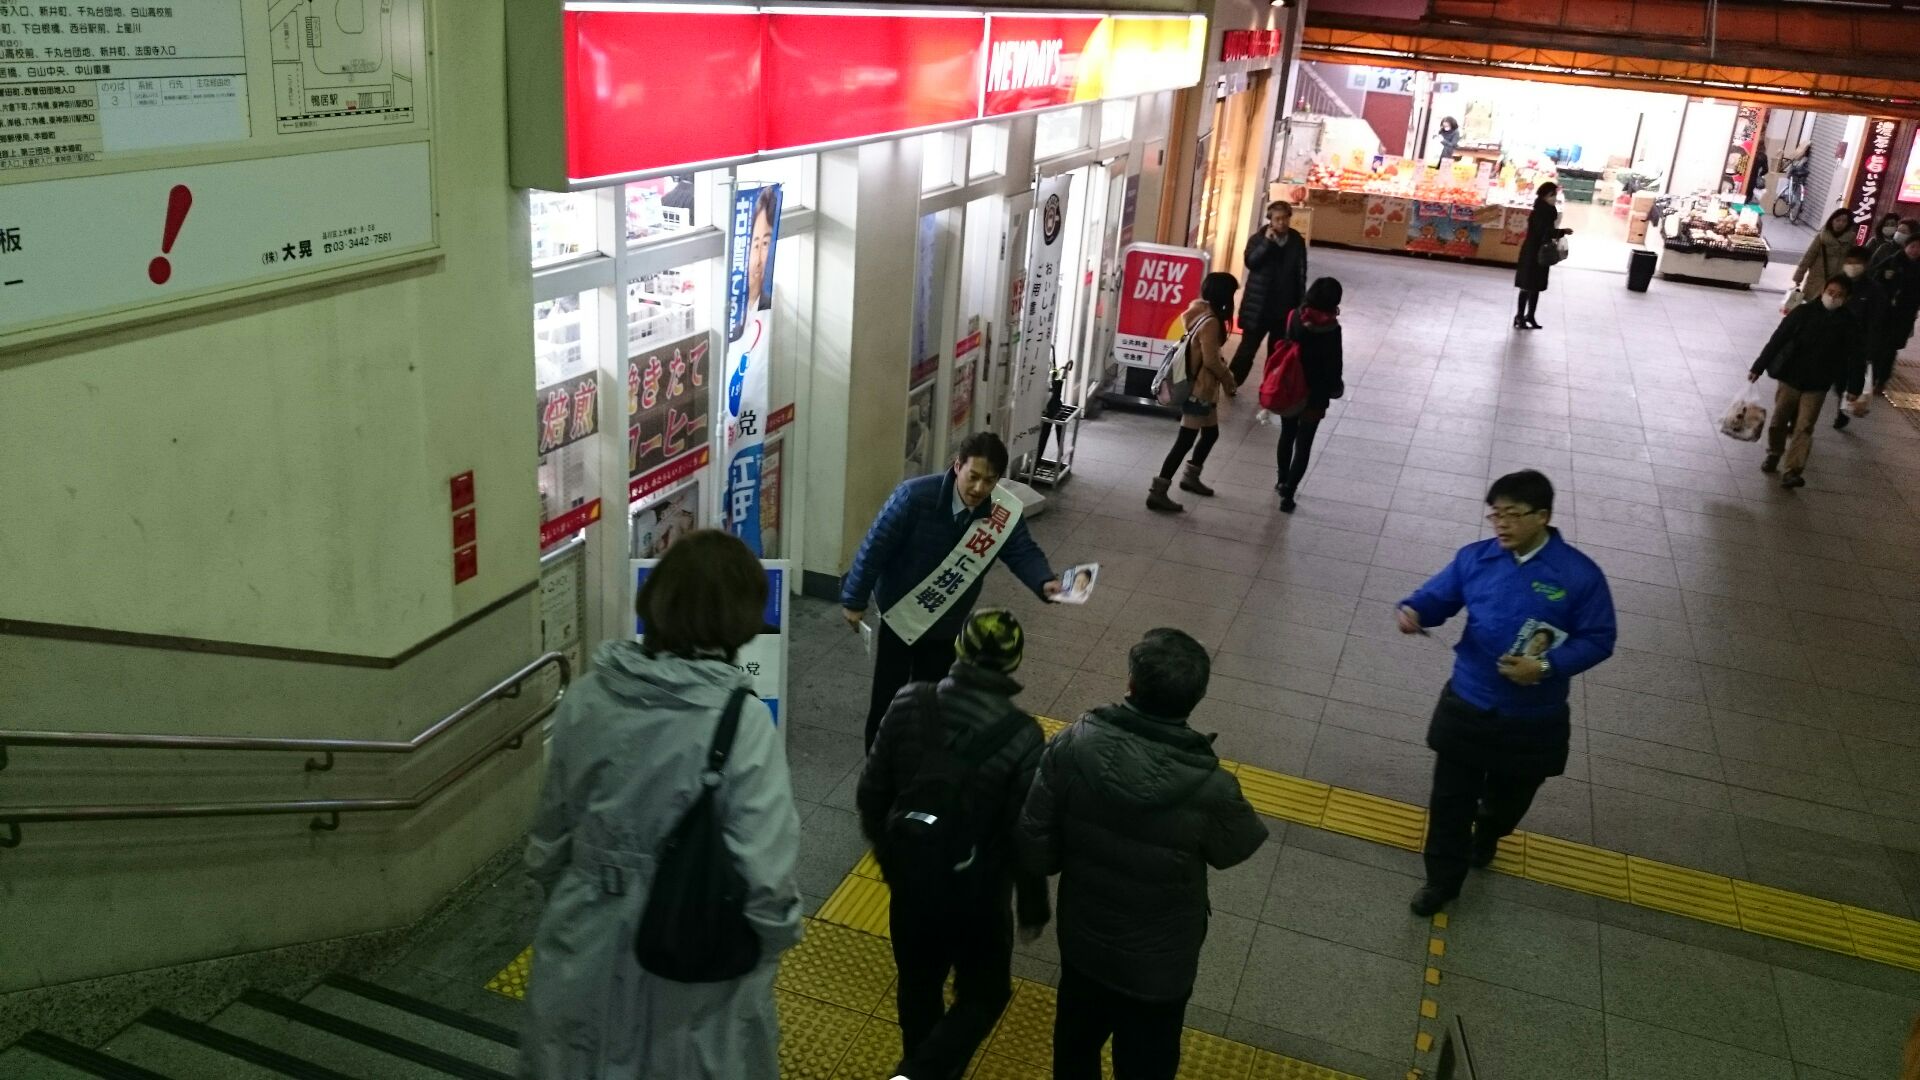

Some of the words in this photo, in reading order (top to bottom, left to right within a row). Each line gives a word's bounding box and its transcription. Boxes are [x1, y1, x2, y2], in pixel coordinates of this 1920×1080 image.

[101, 82, 125, 92] のりば
[168, 79, 184, 89] 行先
[1138, 258, 1189, 284] NEW
[1133, 280, 1184, 305] DAYS
[732, 455, 757, 538] 江田
[915, 502, 1012, 614] 県政に挑戦
